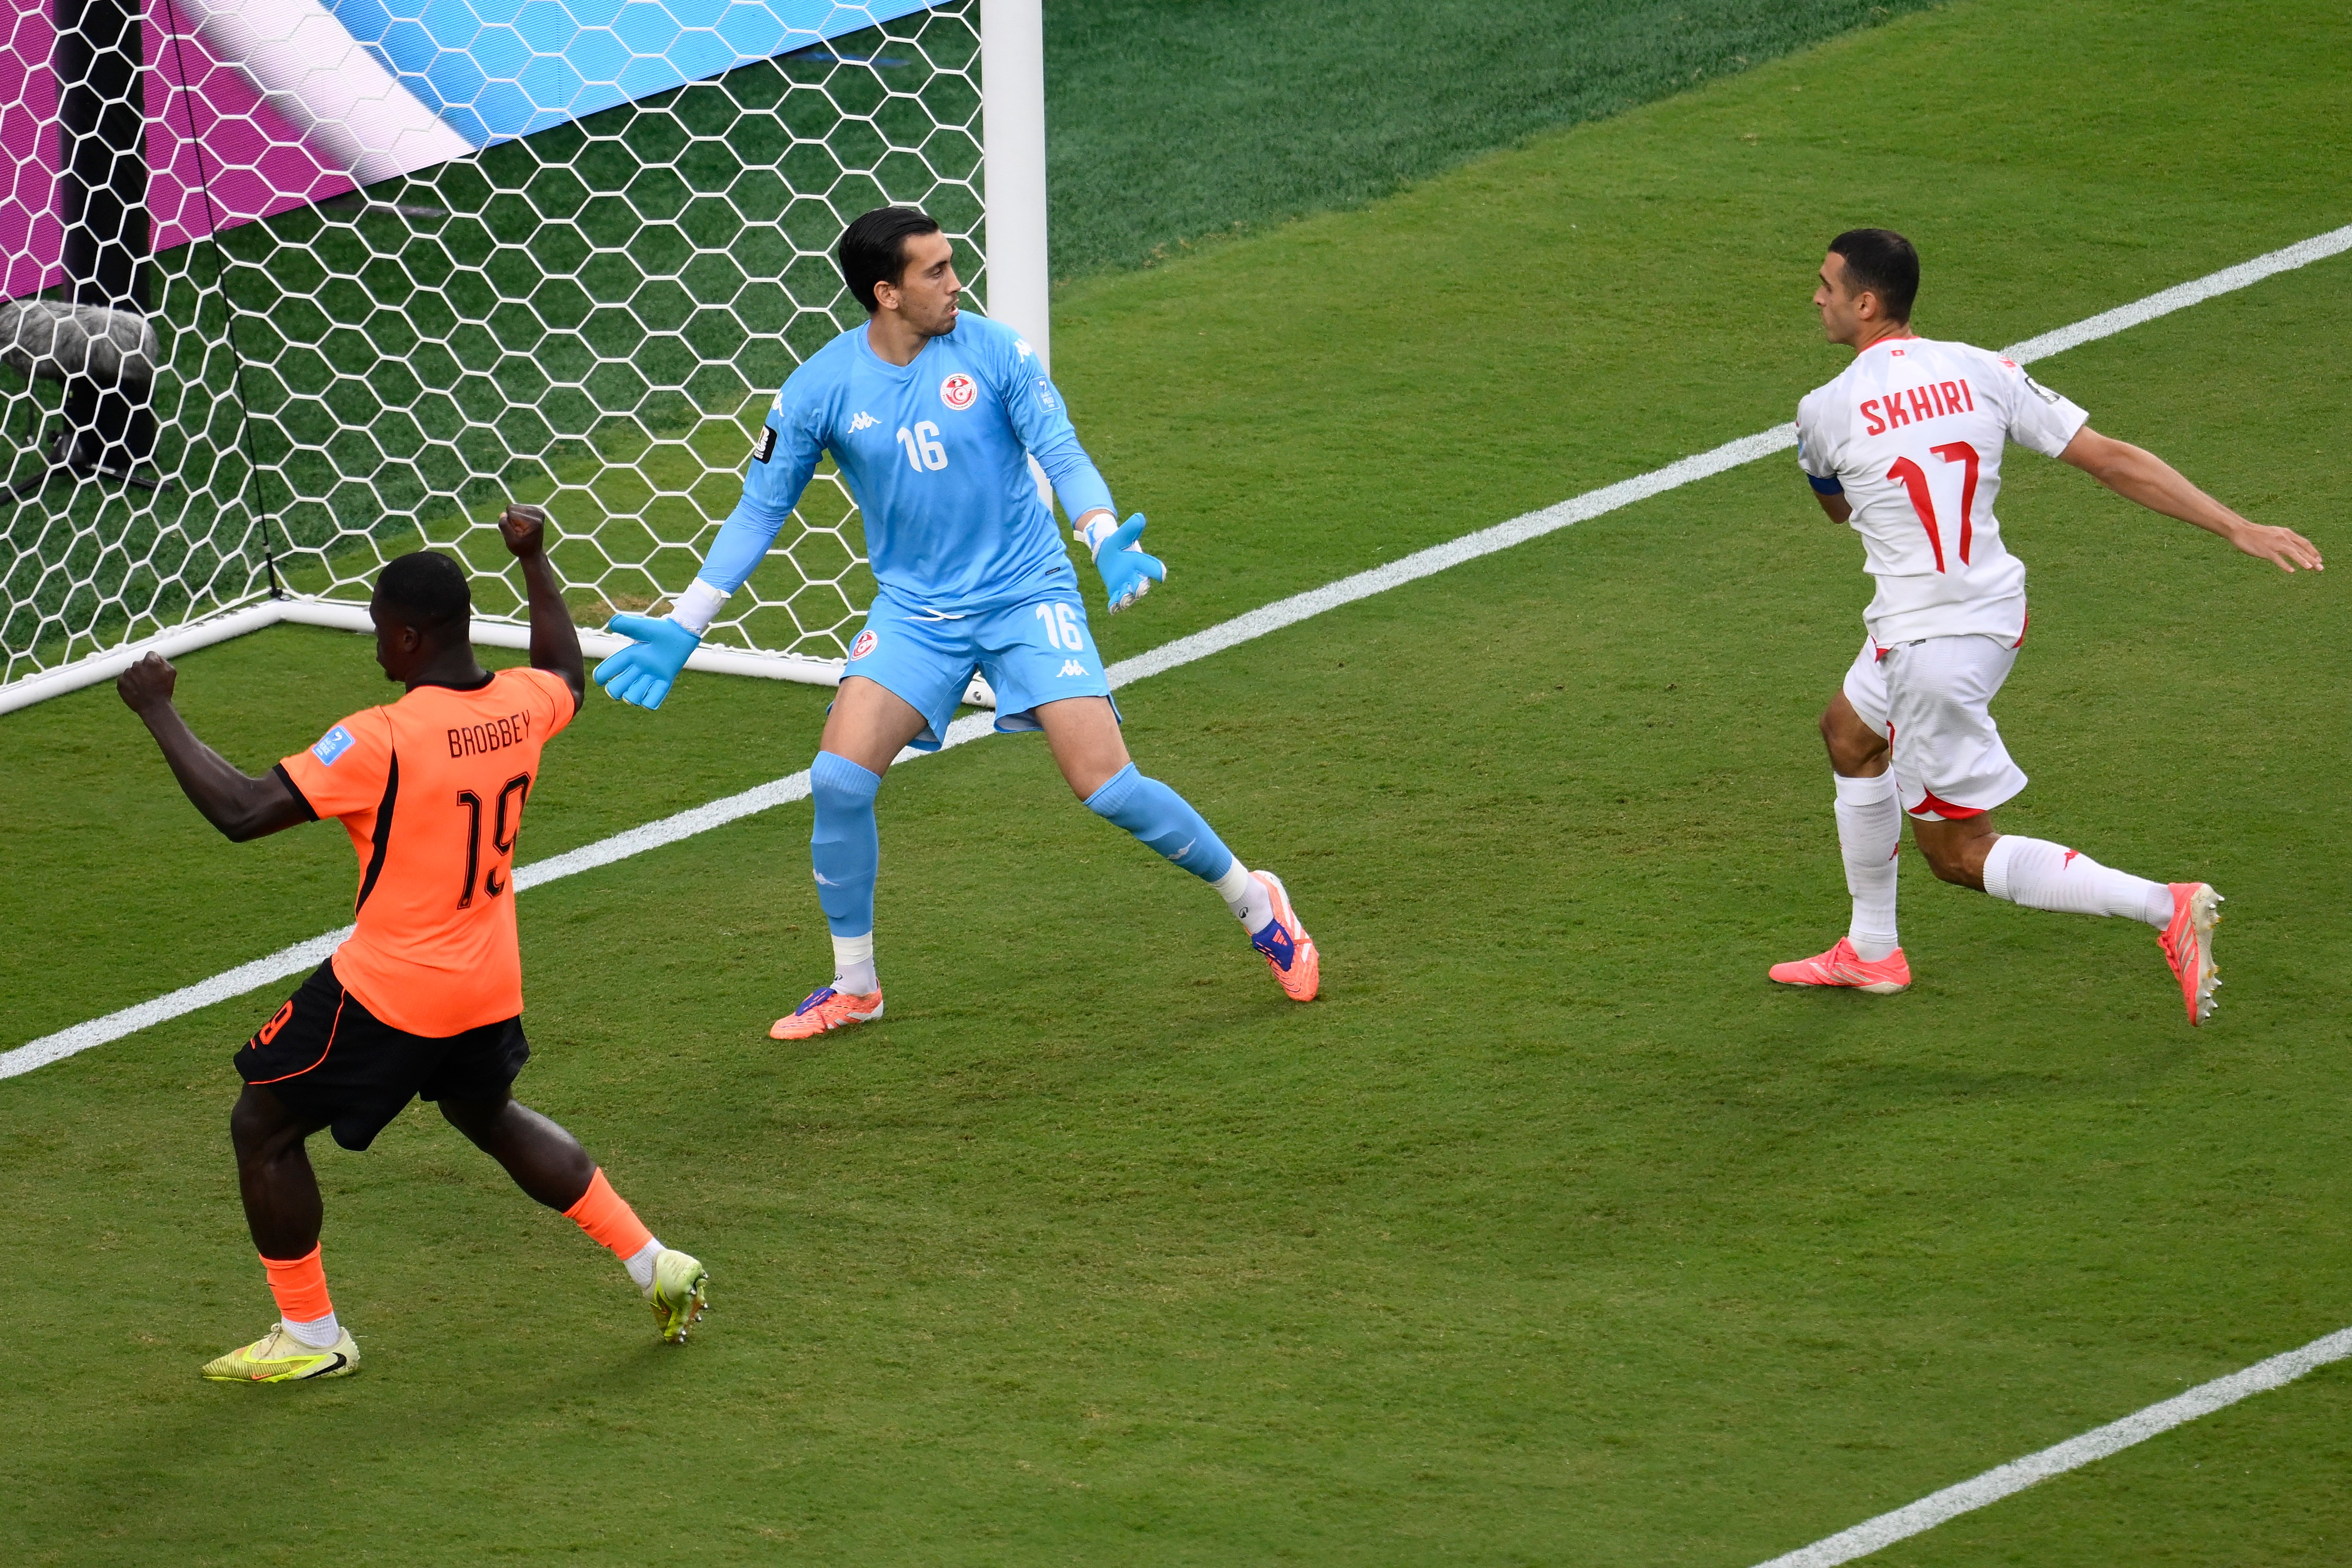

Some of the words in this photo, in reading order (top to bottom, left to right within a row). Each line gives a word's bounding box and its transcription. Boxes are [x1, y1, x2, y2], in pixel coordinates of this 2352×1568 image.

[1860, 379, 1974, 436] SKHIRI
[896, 420, 948, 473] 16
[1886, 441, 1980, 574] 17
[1036, 602, 1083, 650] 16
[448, 709, 530, 759] BROBBEY
[457, 771, 531, 910] 19
